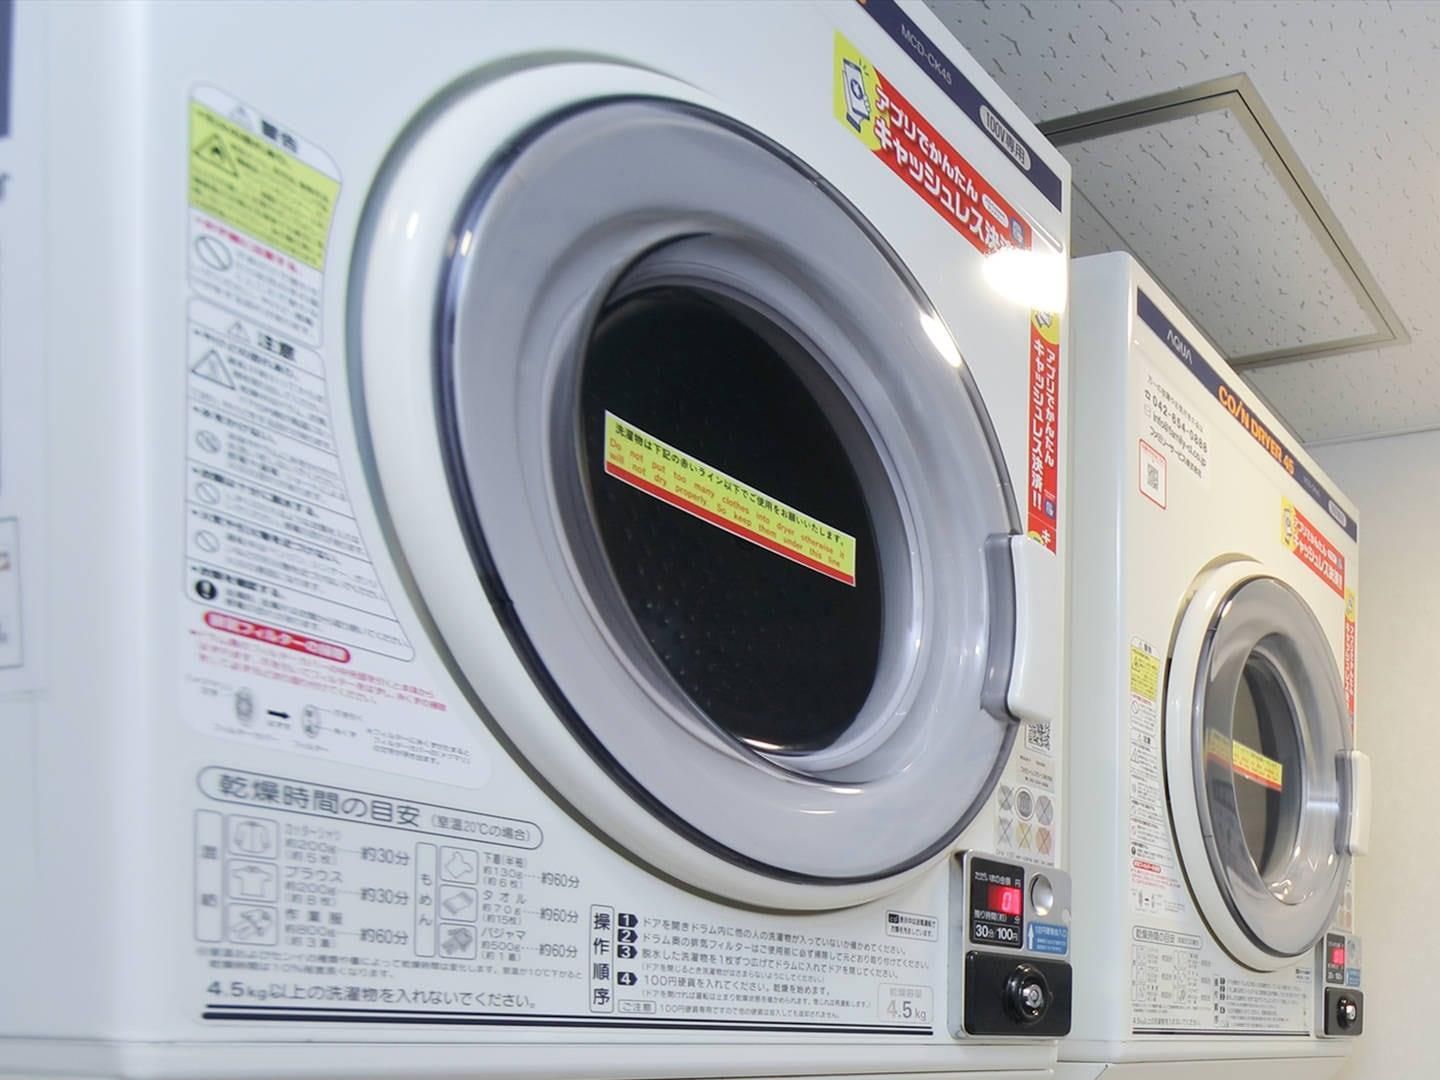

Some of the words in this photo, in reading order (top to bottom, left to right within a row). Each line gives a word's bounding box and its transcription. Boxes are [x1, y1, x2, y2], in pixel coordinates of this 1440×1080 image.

[875, 85, 978, 203] アプリでかんたん
[985, 111, 1026, 166] 100V専用
[1167, 329, 1193, 364] AQUA
[630, 450, 643, 463] not
[651, 461, 666, 475] put
[673, 470, 687, 483] too
[694, 482, 715, 498] many
[721, 495, 749, 515] clothes
[756, 510, 770, 525] into
[632, 463, 646, 476] not
[654, 474, 667, 487] dry
[733, 512, 752, 529] keep
[758, 523, 777, 539] them
[783, 535, 803, 551] under
[808, 547, 822, 561] this
[218, 774, 421, 828] 乾燥時間の目安
[593, 913, 611, 1006] 操作順序
[622, 1002, 651, 1012] ご注意
